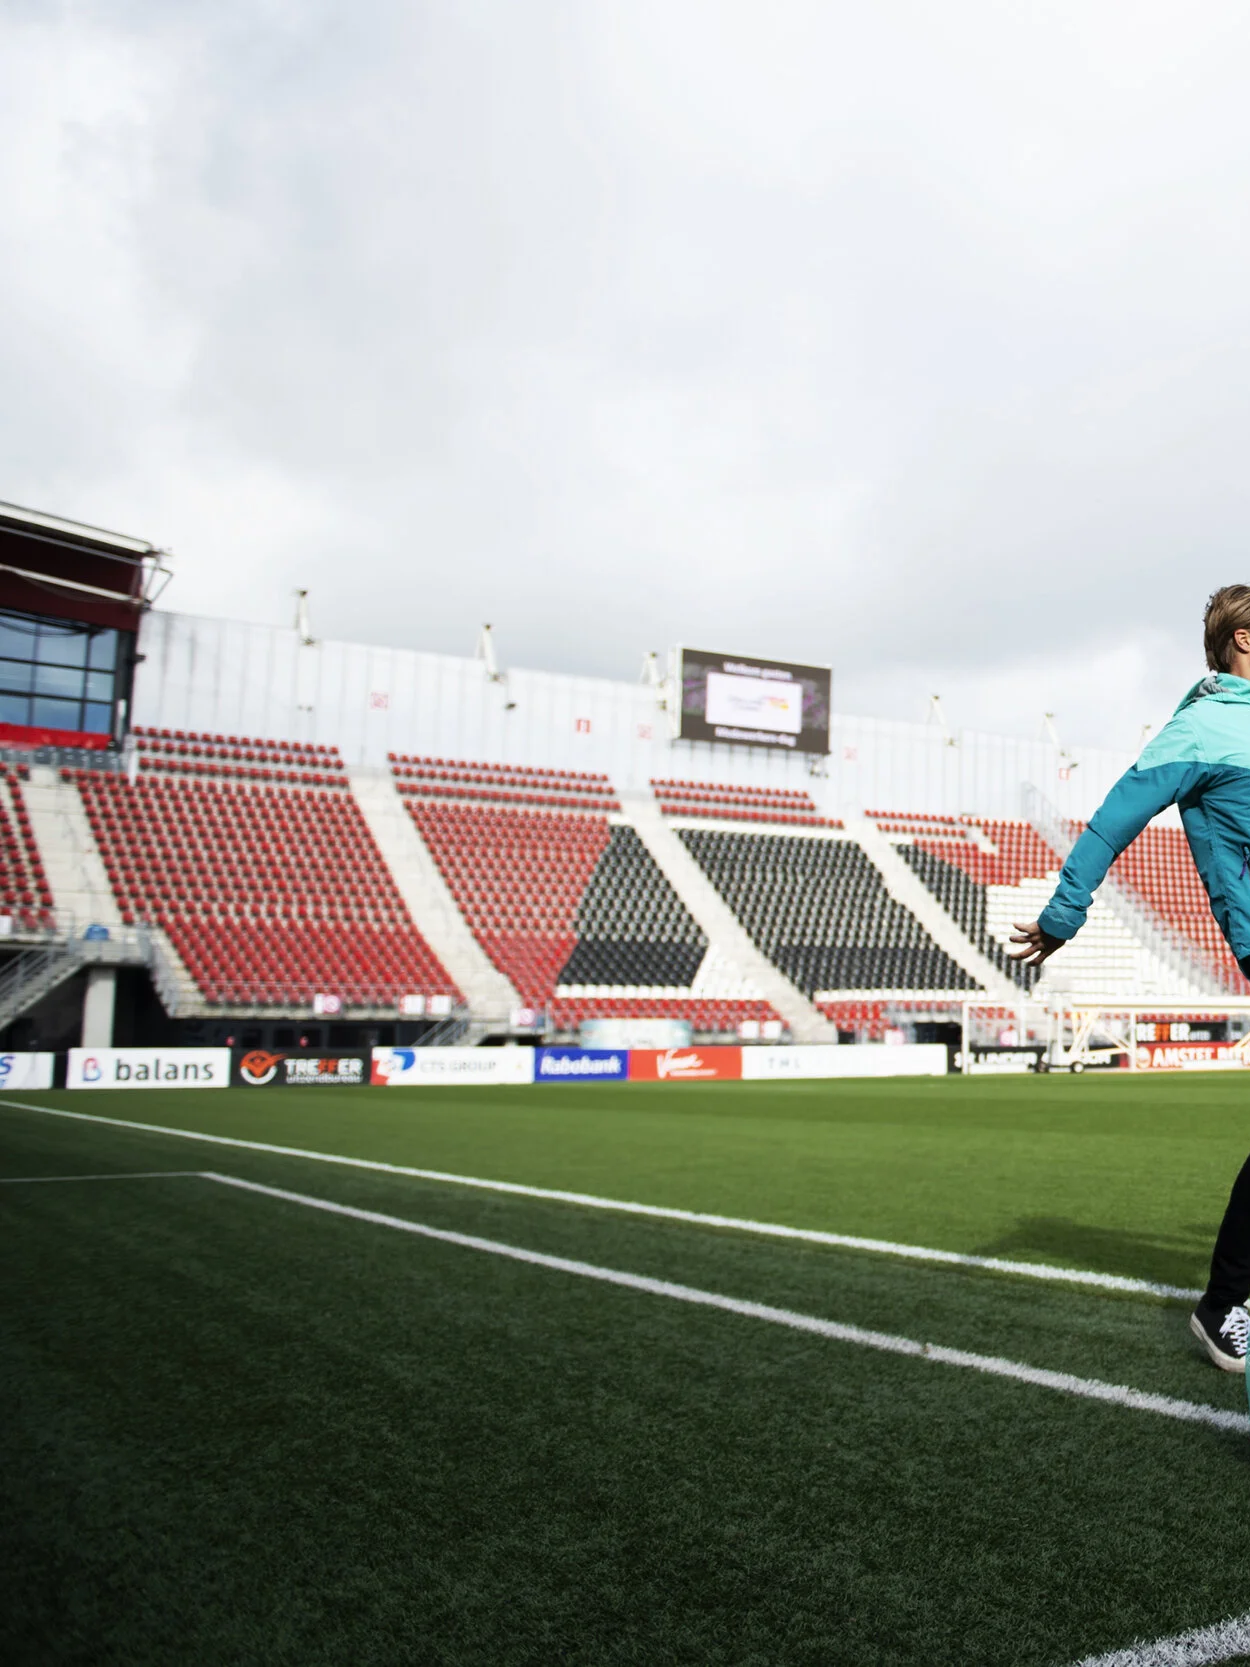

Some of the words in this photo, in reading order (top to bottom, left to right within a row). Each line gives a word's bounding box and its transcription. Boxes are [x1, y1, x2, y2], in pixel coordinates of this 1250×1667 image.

[114, 1058, 215, 1081] balans
[284, 1058, 364, 1076] TREFFER
[540, 1056, 621, 1075] Rabobank
